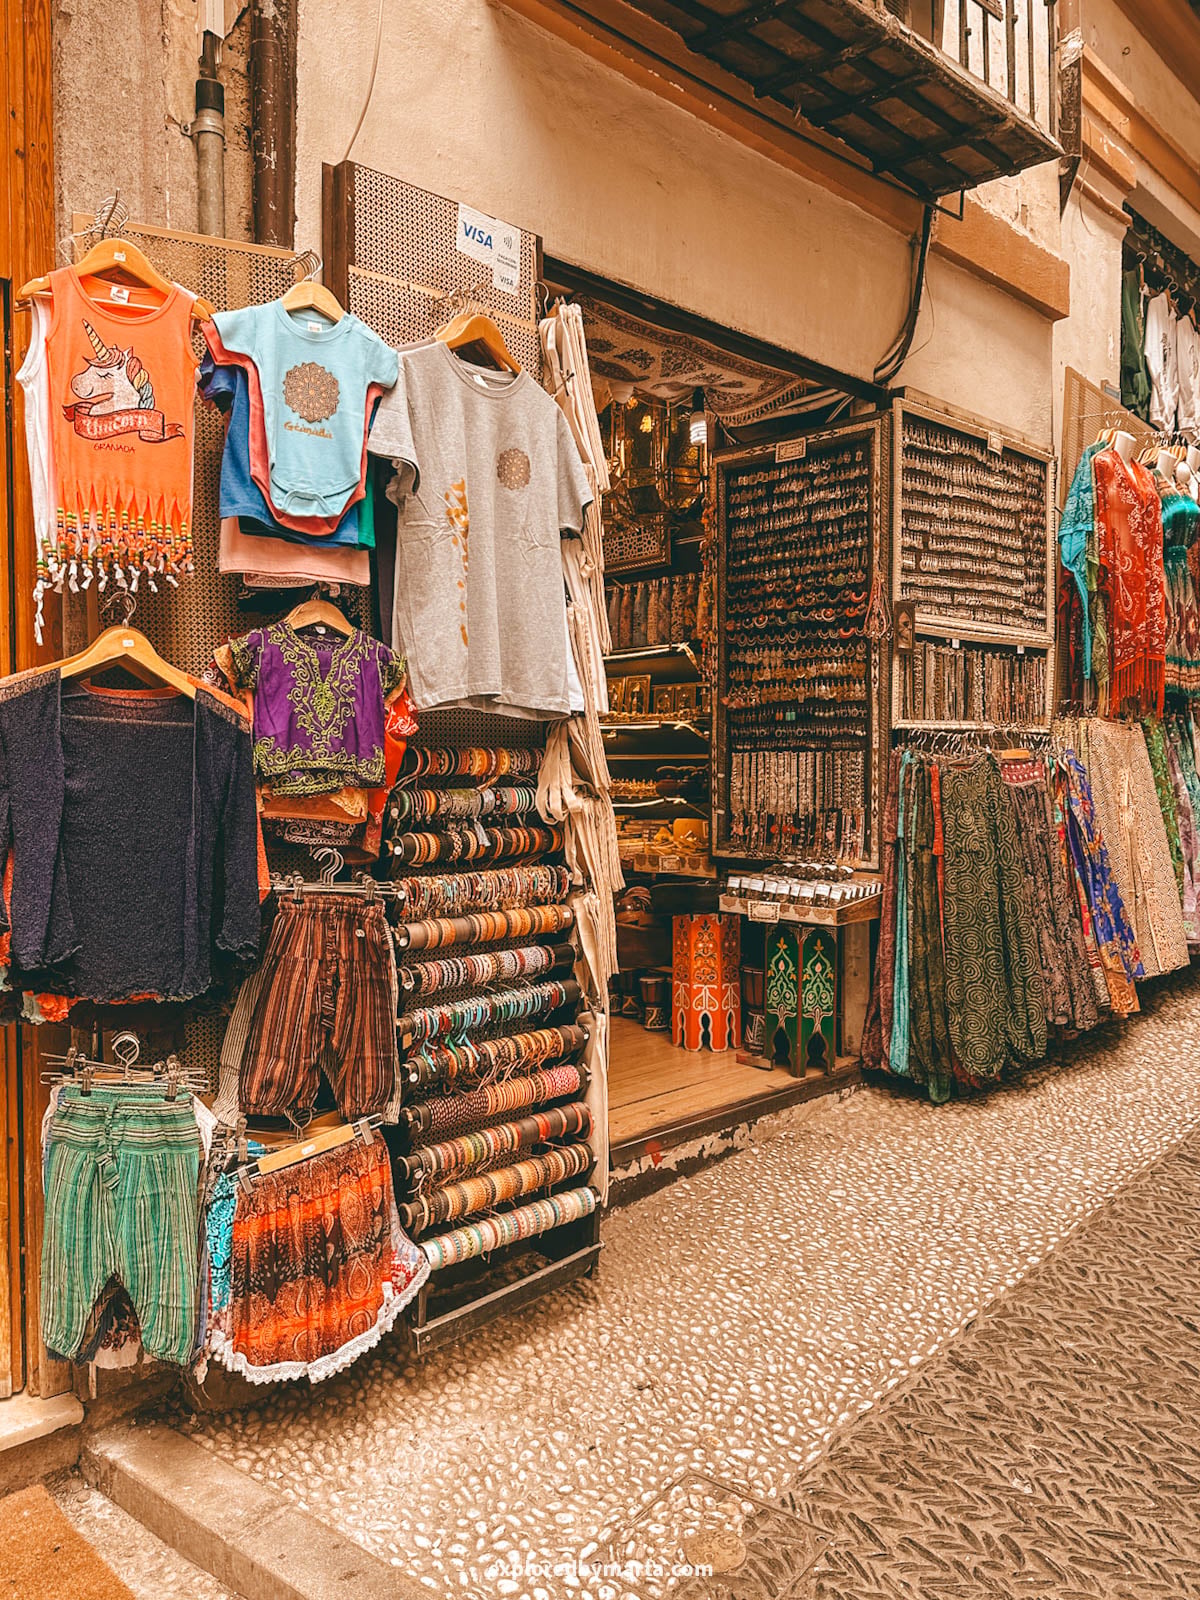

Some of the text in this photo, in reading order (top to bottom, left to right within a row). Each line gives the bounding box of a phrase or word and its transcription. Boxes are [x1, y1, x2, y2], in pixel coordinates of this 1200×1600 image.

[461, 220, 493, 250] VISA
[500, 275, 514, 287] VISA
[93, 442, 136, 455] GRANADA
